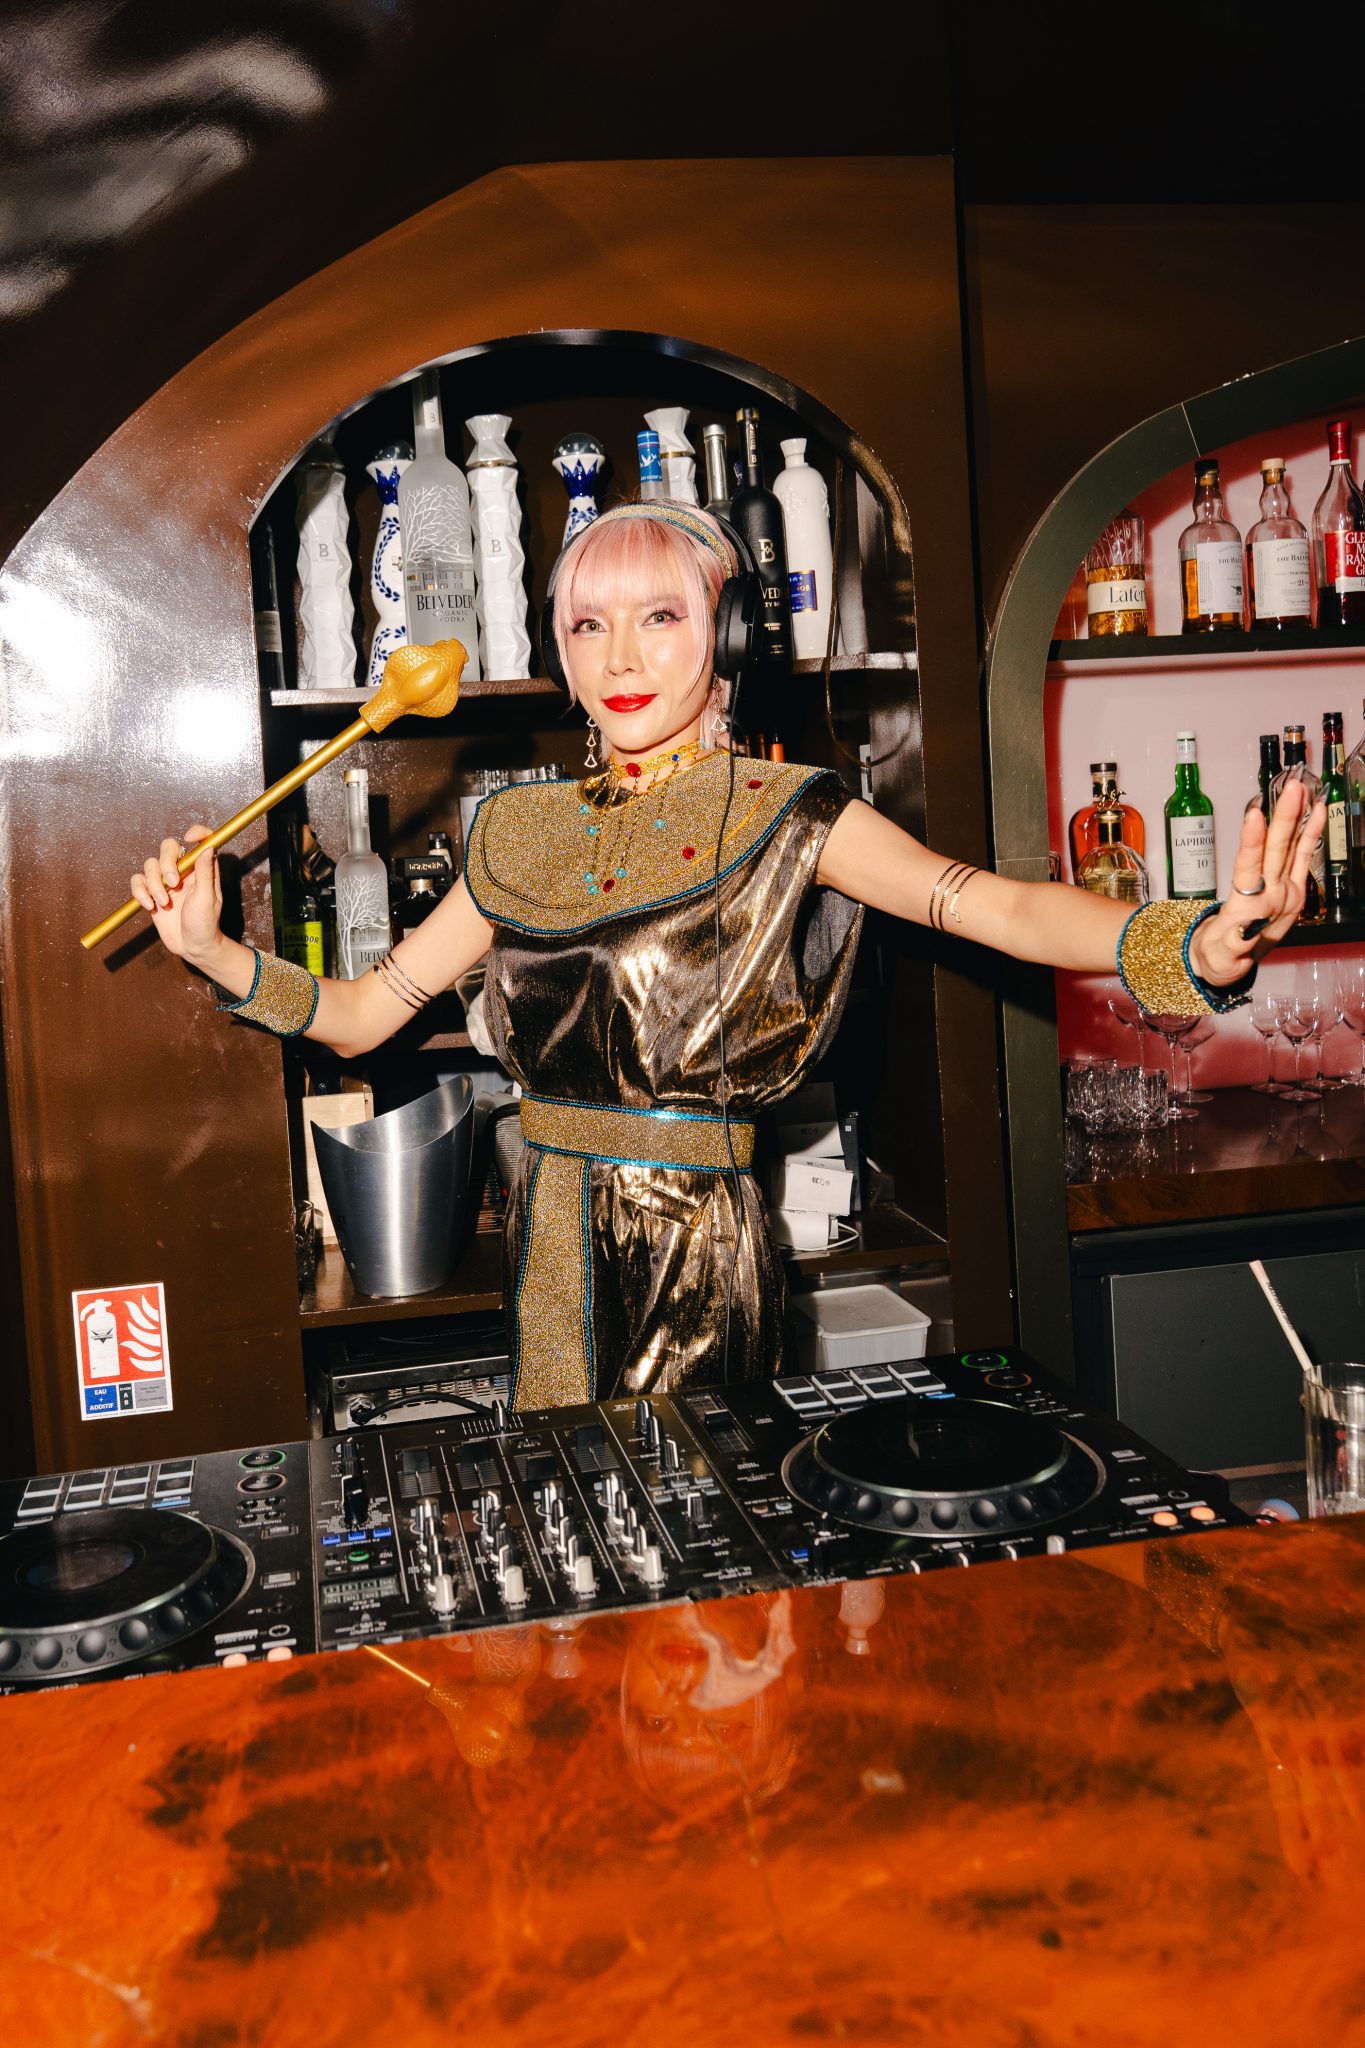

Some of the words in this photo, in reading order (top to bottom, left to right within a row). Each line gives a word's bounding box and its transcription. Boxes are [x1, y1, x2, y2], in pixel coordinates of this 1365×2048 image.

[318, 543, 329, 558] B
[491, 538, 503, 553] B
[1196, 858, 1208, 869] 10
[89, 1403, 114, 1411] ADDITIF
